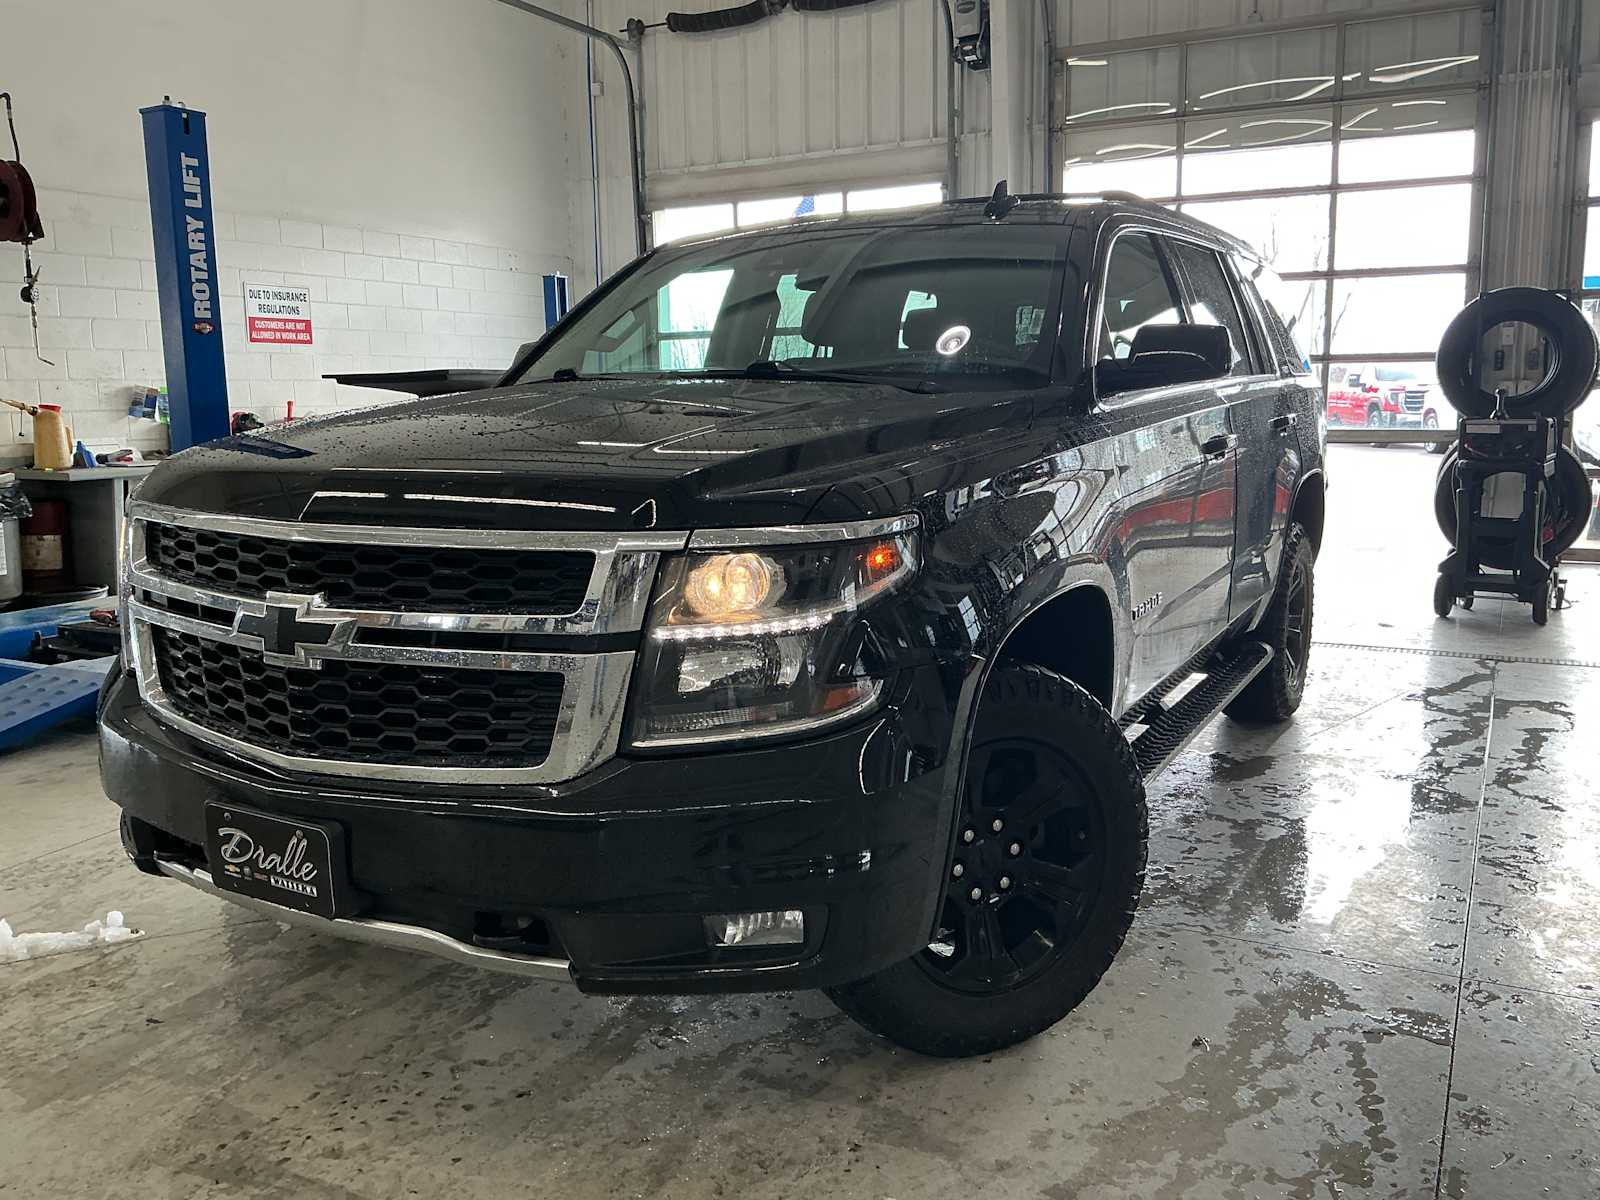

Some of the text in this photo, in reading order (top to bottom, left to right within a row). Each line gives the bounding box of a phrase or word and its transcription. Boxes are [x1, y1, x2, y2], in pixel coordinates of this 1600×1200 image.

[180, 152, 212, 319] ROTARY LIFT
[249, 289, 307, 302] DUE TO INSURANCE
[258, 304, 300, 315] REGULATIONS
[255, 321, 285, 329] CUSTOMERS
[252, 331, 274, 339] ALLOWED
[217, 827, 318, 881] Dralle
